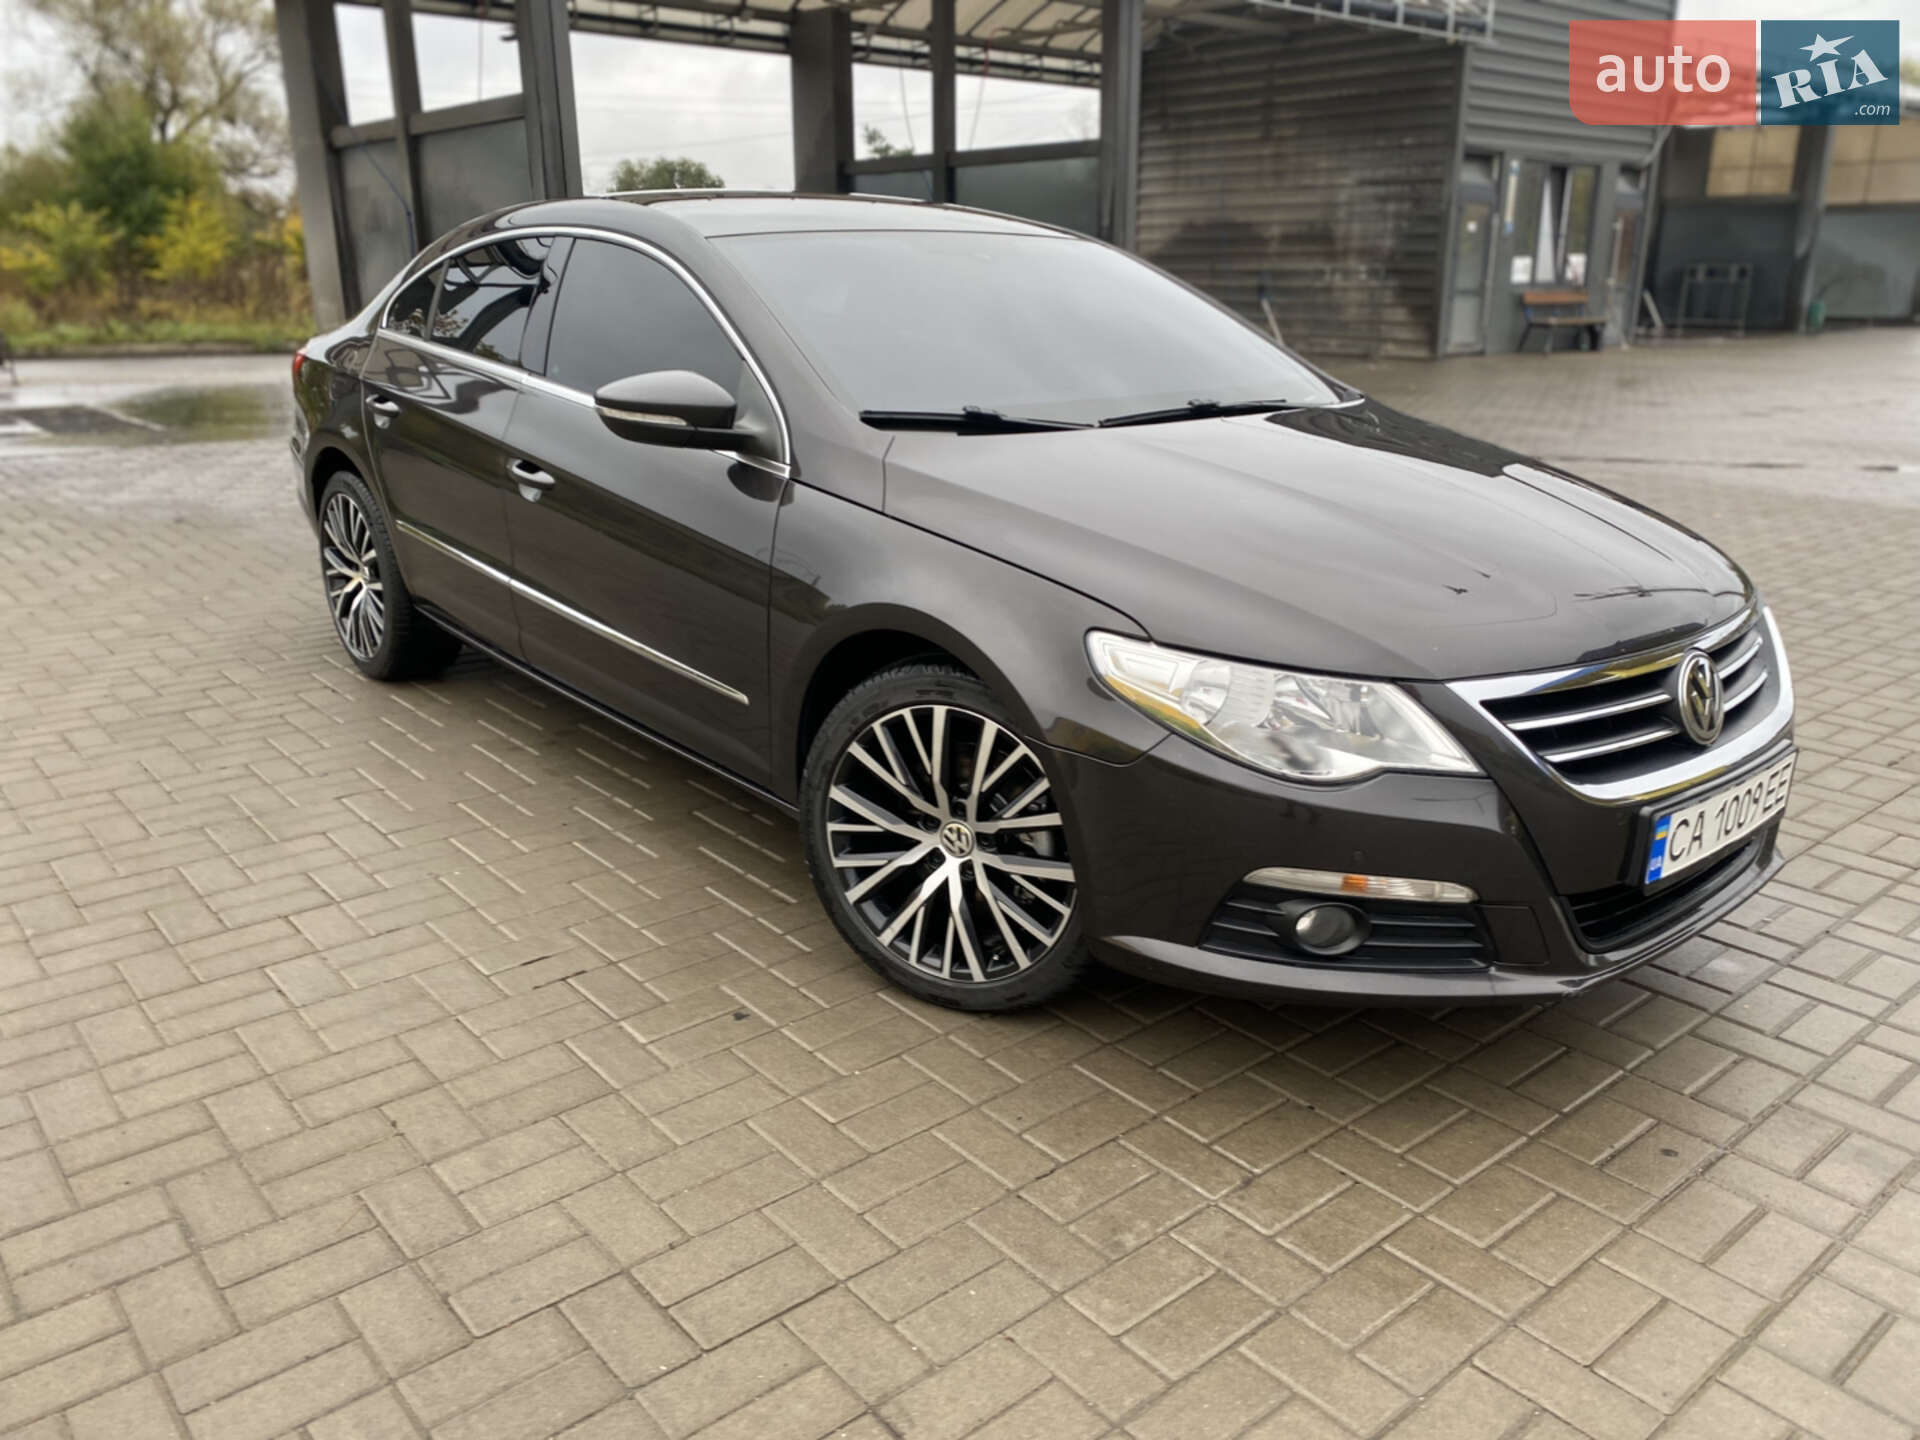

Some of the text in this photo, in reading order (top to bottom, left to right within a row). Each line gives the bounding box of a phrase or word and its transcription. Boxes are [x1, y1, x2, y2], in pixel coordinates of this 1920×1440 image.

[1669, 762, 1791, 862] CA 1009 EE
